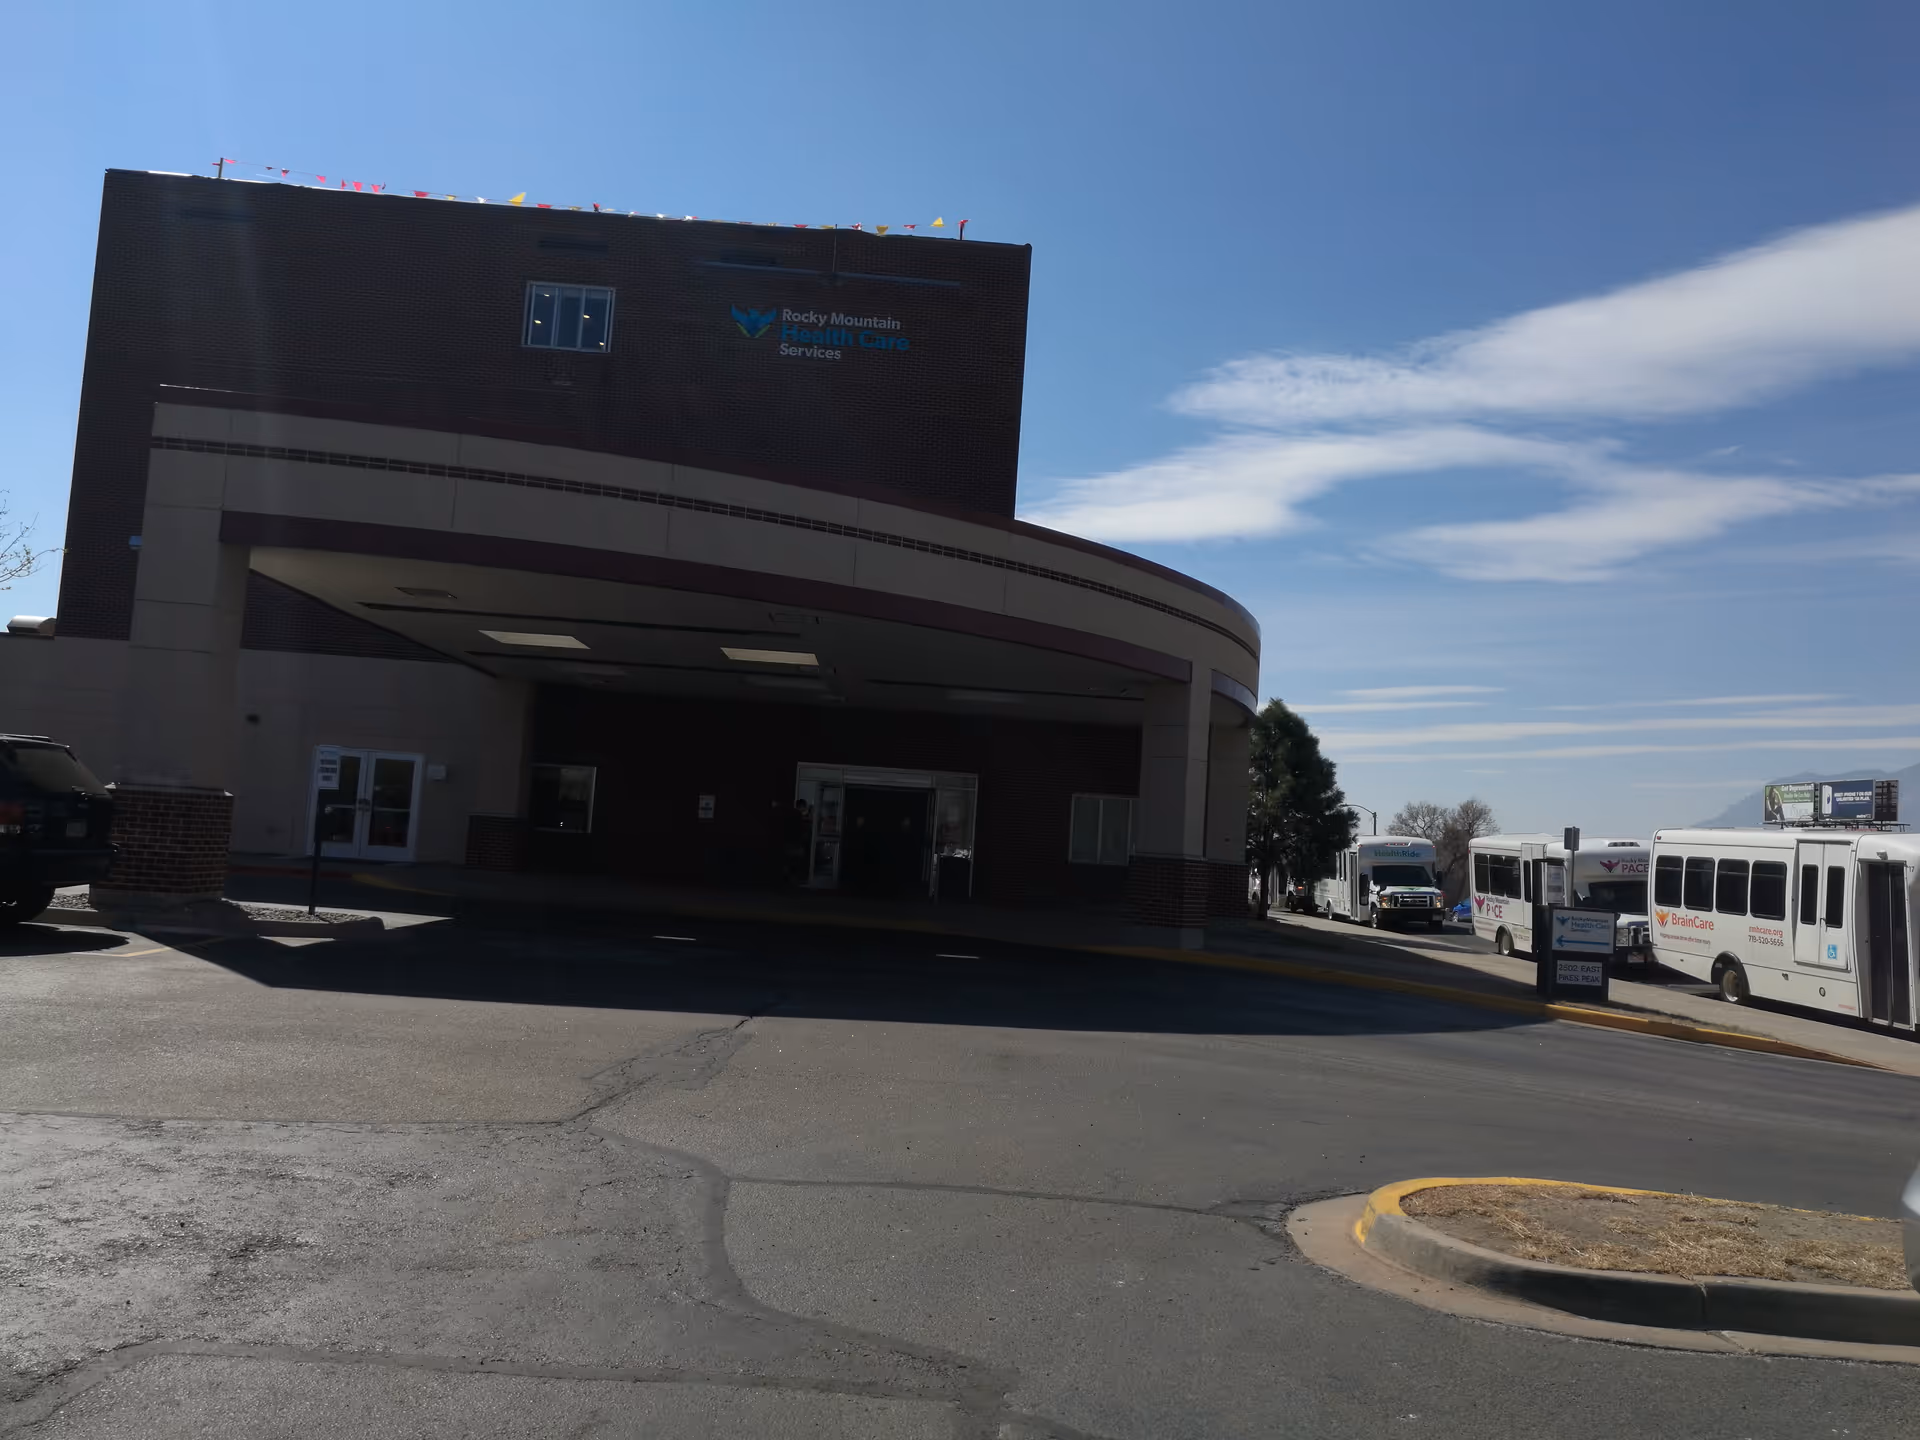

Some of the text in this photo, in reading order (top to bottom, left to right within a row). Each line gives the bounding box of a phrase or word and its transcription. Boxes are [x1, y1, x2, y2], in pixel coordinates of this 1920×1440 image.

[782, 308, 902, 330] Rocky Mountain
[781, 322, 912, 351] Health Care
[779, 343, 842, 360] Services
[1621, 863, 1650, 873] PACE
[1486, 903, 1503, 919] PACE
[1671, 912, 1715, 931] BrainCare
[1580, 965, 1602, 973] EAST
[1581, 975, 1601, 983] PEAK
